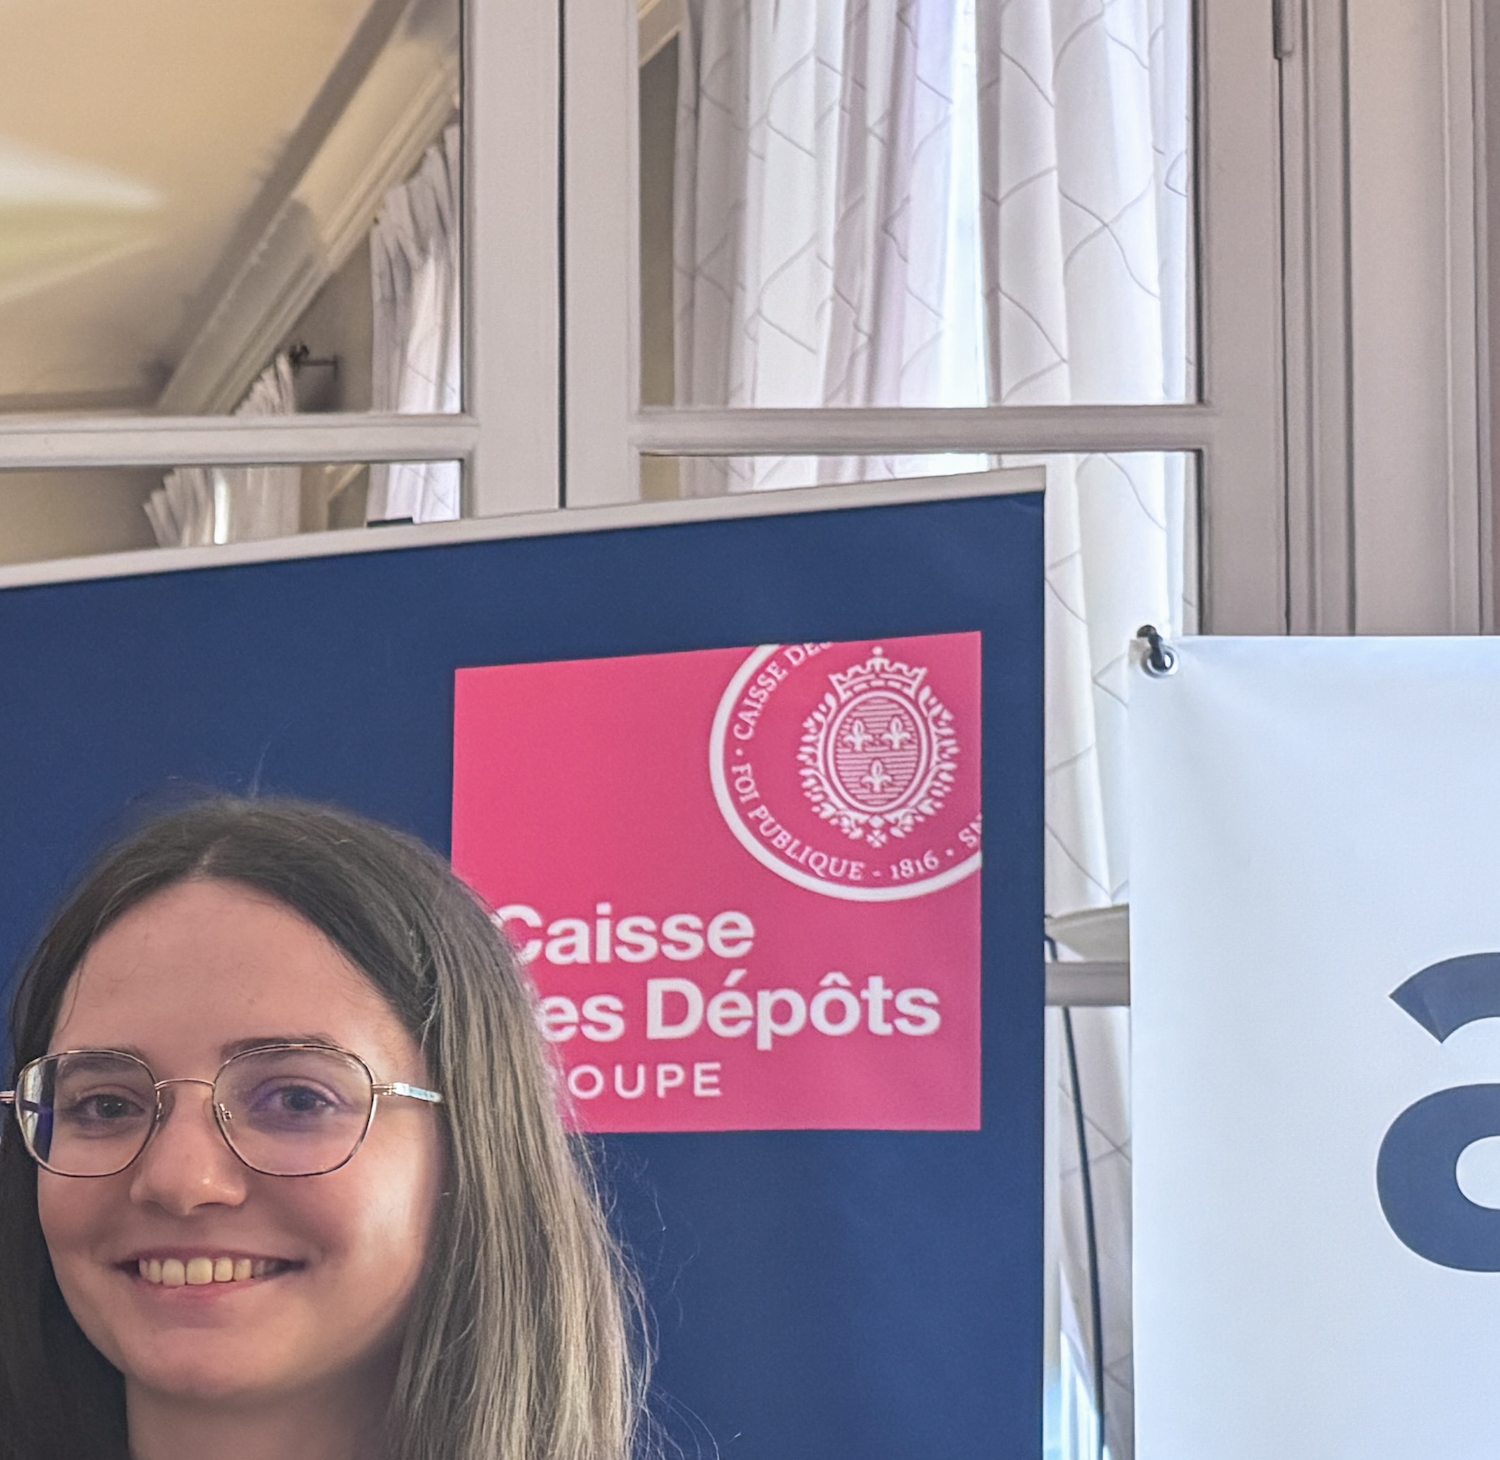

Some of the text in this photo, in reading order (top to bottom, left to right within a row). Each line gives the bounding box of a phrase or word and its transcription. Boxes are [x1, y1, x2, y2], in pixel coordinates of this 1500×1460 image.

[733, 660, 789, 740] CAISSE
[731, 764, 940, 881] FOI PUBLIQUE 1816
[490, 902, 754, 965] Caisse
[540, 969, 941, 1051] es Dépôts
